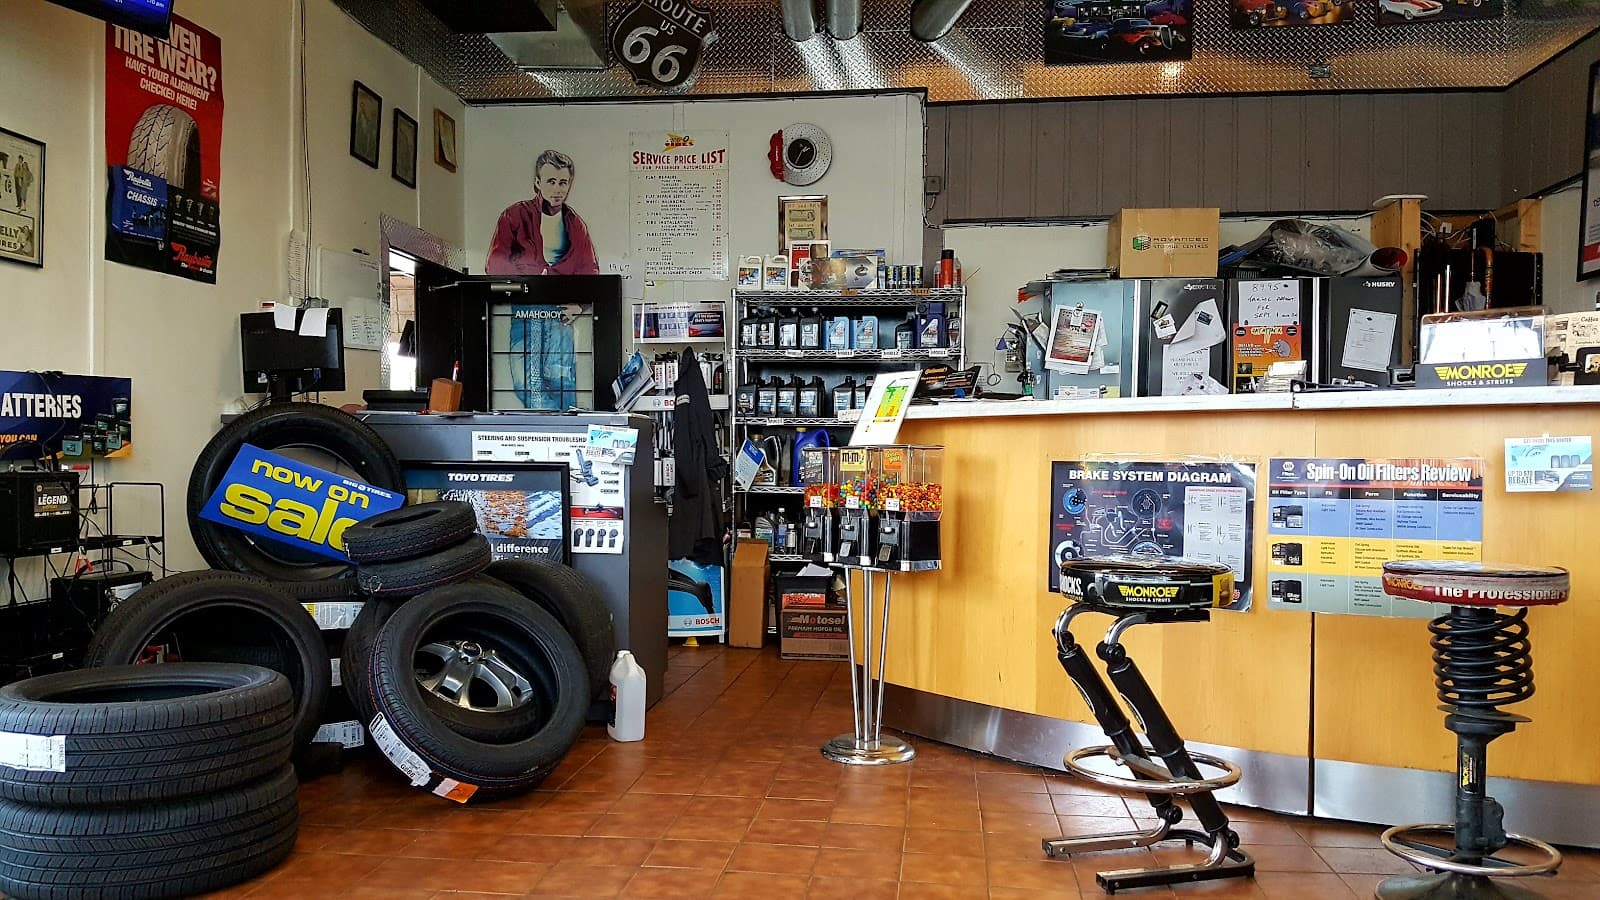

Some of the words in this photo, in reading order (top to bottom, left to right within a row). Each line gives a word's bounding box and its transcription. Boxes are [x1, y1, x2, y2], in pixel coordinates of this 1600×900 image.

[660, 20, 677, 35] US
[168, 20, 201, 60] VEN
[112, 23, 155, 64] TIRE
[157, 41, 217, 91] WEAR?
[622, 26, 688, 82] 66
[125, 56, 147, 75] HAVE
[148, 65, 169, 84] YOUR
[170, 76, 210, 102] ALIGNMENT
[140, 77, 176, 100] CHECKED
[176, 92, 197, 110] HERE!
[632, 150, 671, 165] SERVICE
[674, 154, 697, 164] PRICE
[701, 148, 726, 164] LIST
[126, 190, 158, 207] CHASSIS
[0, 225, 19, 239] ELLY
[1444, 363, 1518, 380] MONROE
[0, 392, 82, 419] ATTERIES
[477, 434, 504, 442] STEERING
[517, 435, 551, 443] SUSPENSION
[447, 473, 480, 482] TOYO
[480, 473, 515, 482] TIRES
[1069, 469, 1109, 480] BRAKE
[1112, 471, 1164, 482] SYSTEM
[1167, 471, 1232, 483] DIAGRAM
[1306, 463, 1355, 482] Spin-On
[1357, 463, 1373, 480] Oil
[1375, 463, 1420, 481] Filters
[1421, 464, 1472, 481] Review
[251, 458, 323, 493] now
[328, 484, 370, 509] on
[342, 479, 358, 488] BIG
[365, 486, 392, 499] TIRES
[37, 494, 68, 505] LEGEND
[496, 543, 549, 553] difference
[1123, 586, 1174, 598] MONROE
[695, 617, 720, 625] BOSCH
[799, 614, 846, 625] Motosel
